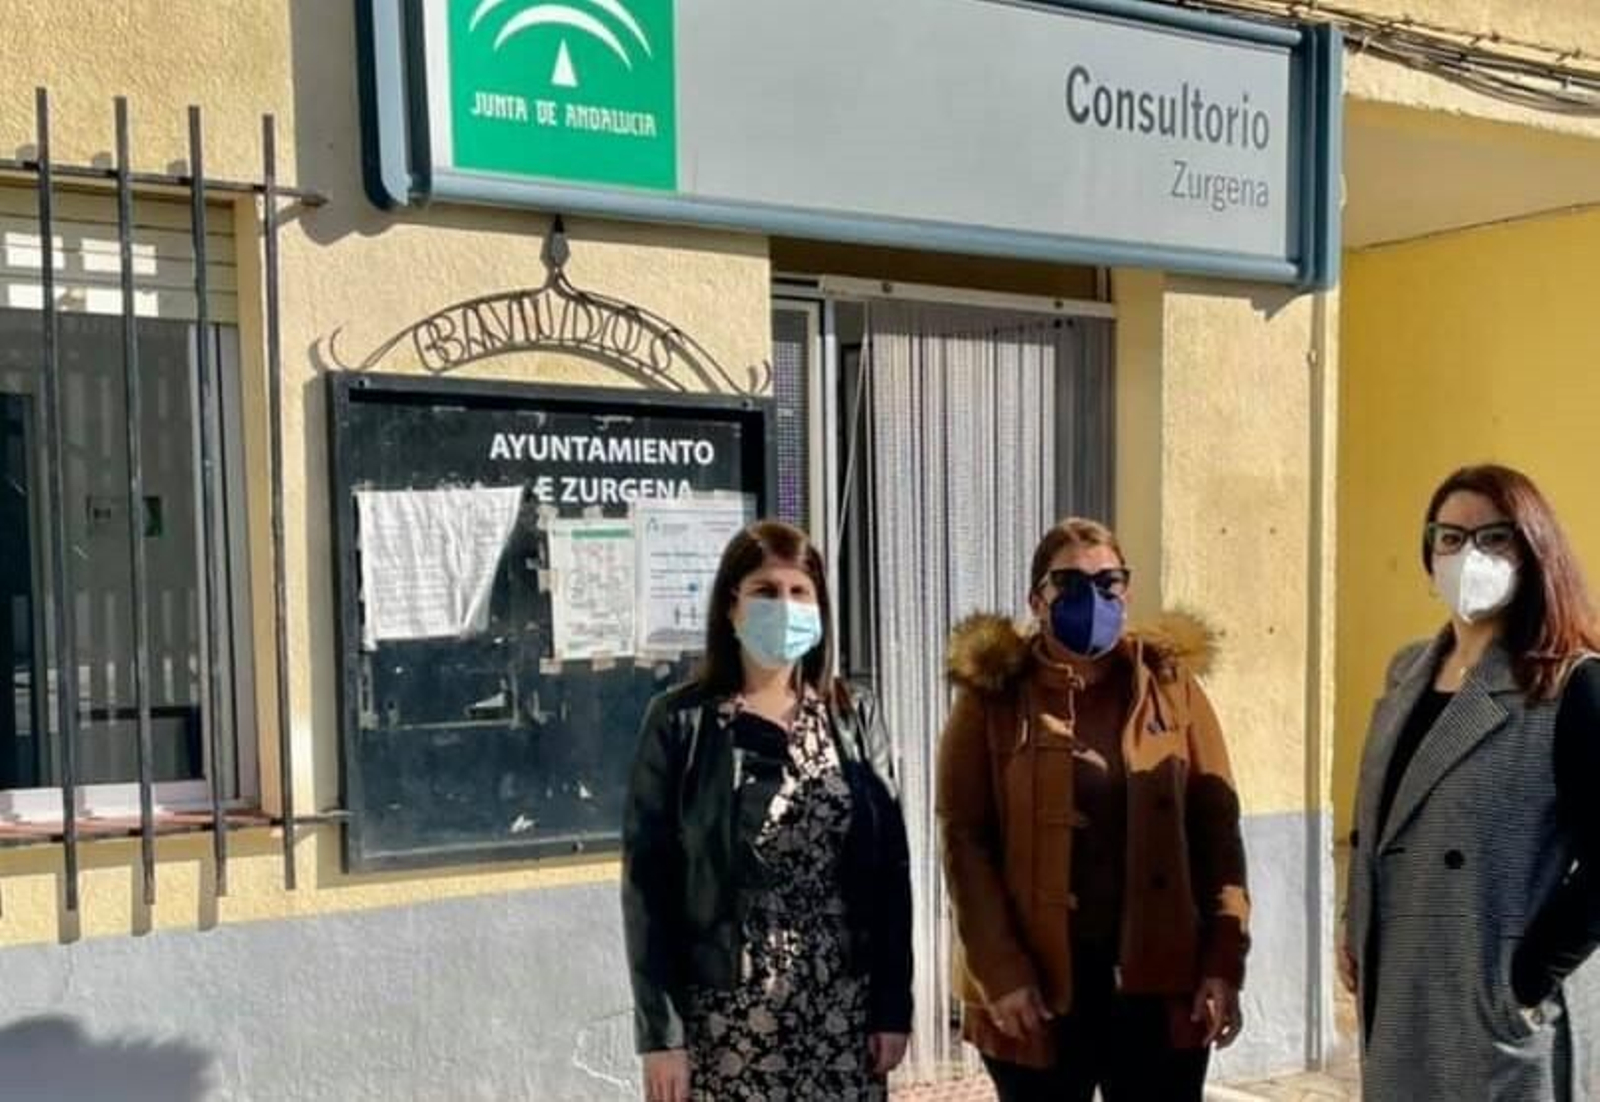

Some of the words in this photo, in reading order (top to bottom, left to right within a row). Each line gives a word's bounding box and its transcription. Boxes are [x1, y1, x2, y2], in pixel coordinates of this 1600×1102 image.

[469, 91, 528, 122] JUNTA
[536, 100, 558, 126] DE
[1065, 64, 1270, 151] Consultorio
[1170, 160, 1269, 212] Zurgena
[489, 433, 715, 465] AYUNTAMIENTO
[532, 475, 554, 502] E
[560, 477, 693, 504] ZURGENA
